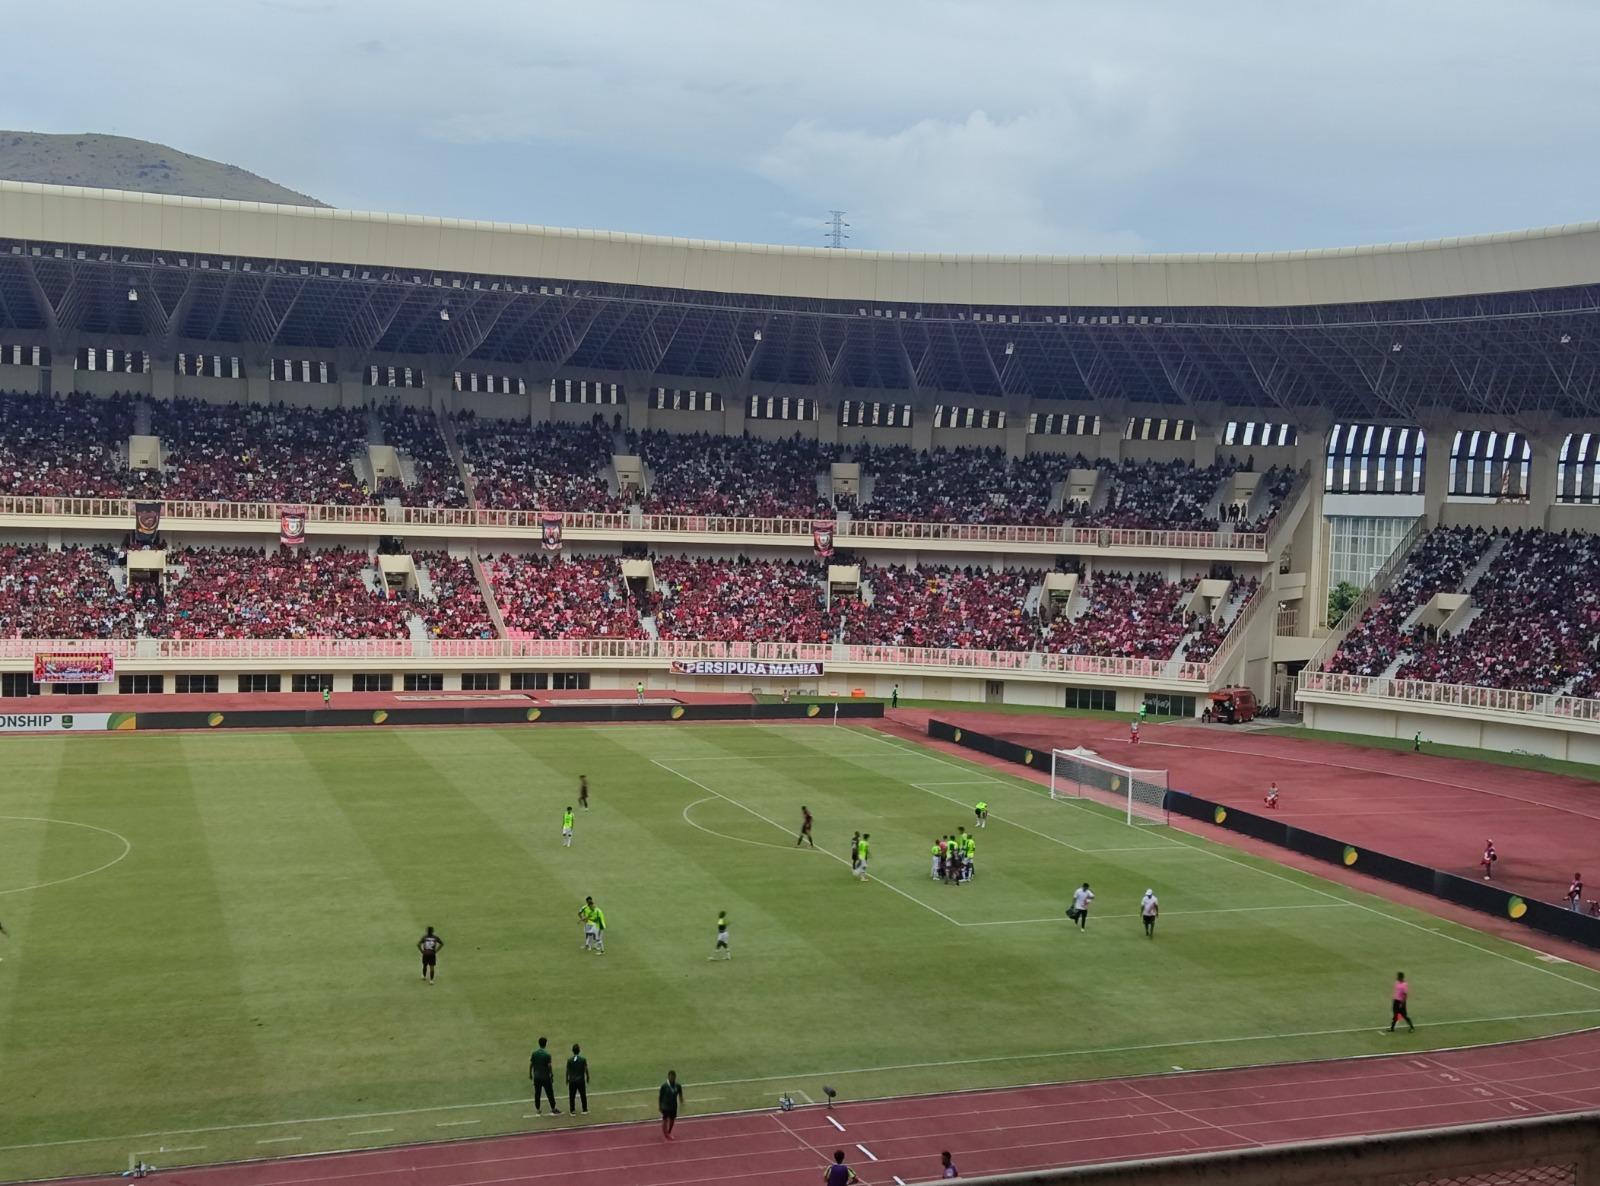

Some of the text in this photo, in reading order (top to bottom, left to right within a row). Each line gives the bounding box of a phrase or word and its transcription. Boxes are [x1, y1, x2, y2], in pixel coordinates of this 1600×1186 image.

[686, 661, 818, 675] PERSIPURA MANIA
[1440, 1073, 1461, 1082] 2
